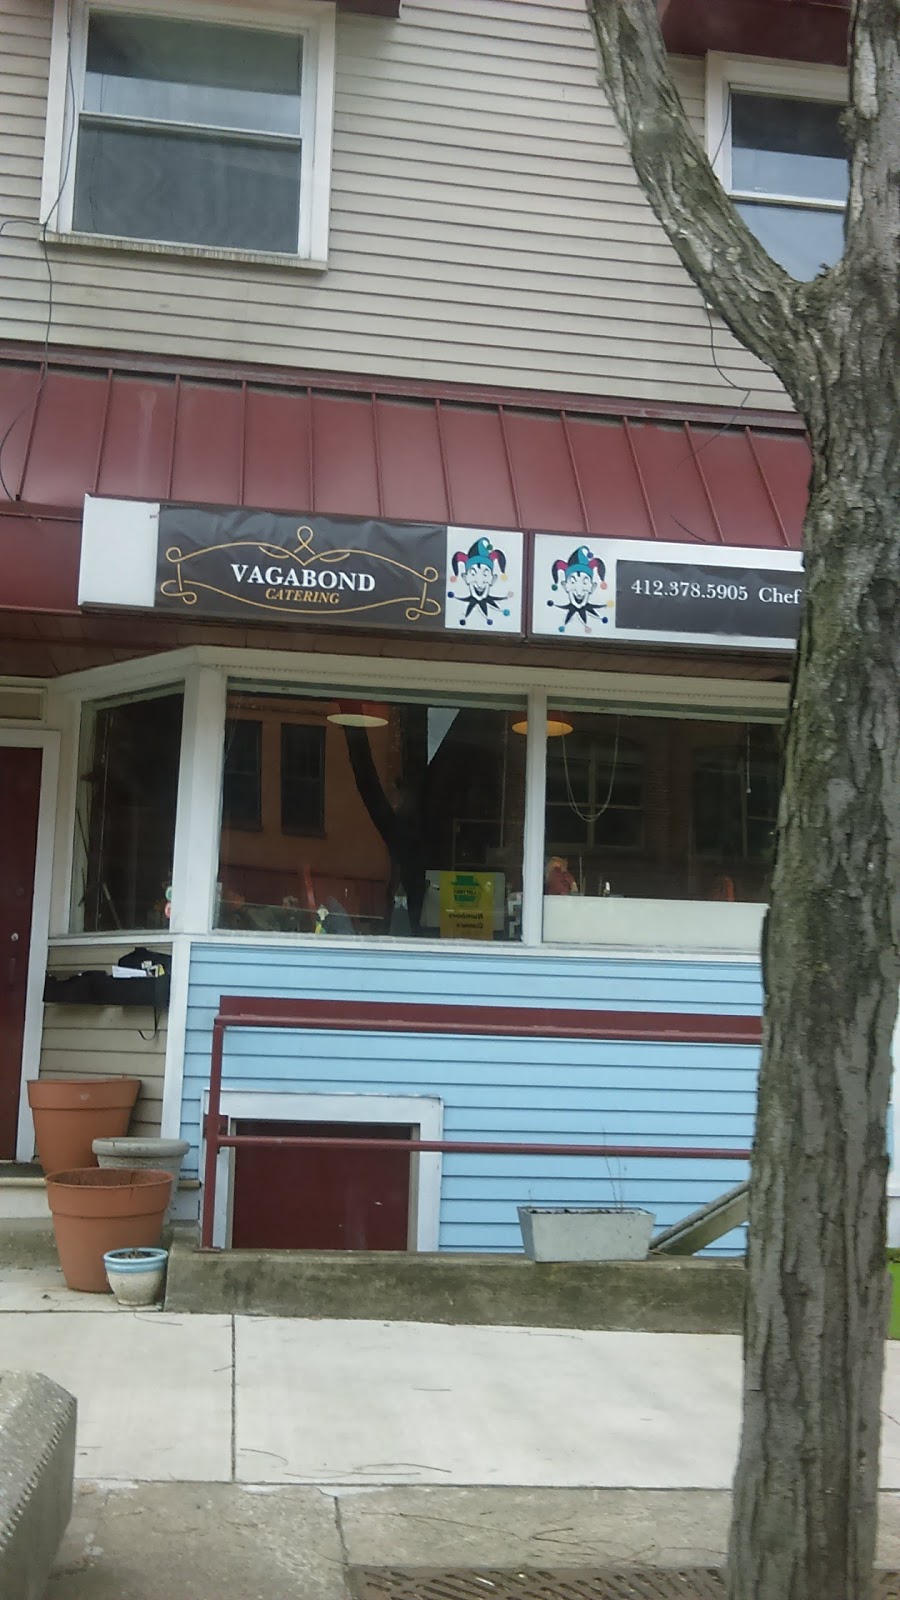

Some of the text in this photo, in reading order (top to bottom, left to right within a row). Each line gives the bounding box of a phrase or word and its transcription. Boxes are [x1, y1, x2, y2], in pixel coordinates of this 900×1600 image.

[230, 563, 376, 592] VAGABOND
[265, 588, 340, 604] CATERING
[630, 579, 803, 605] 412.378.5905 Chef
